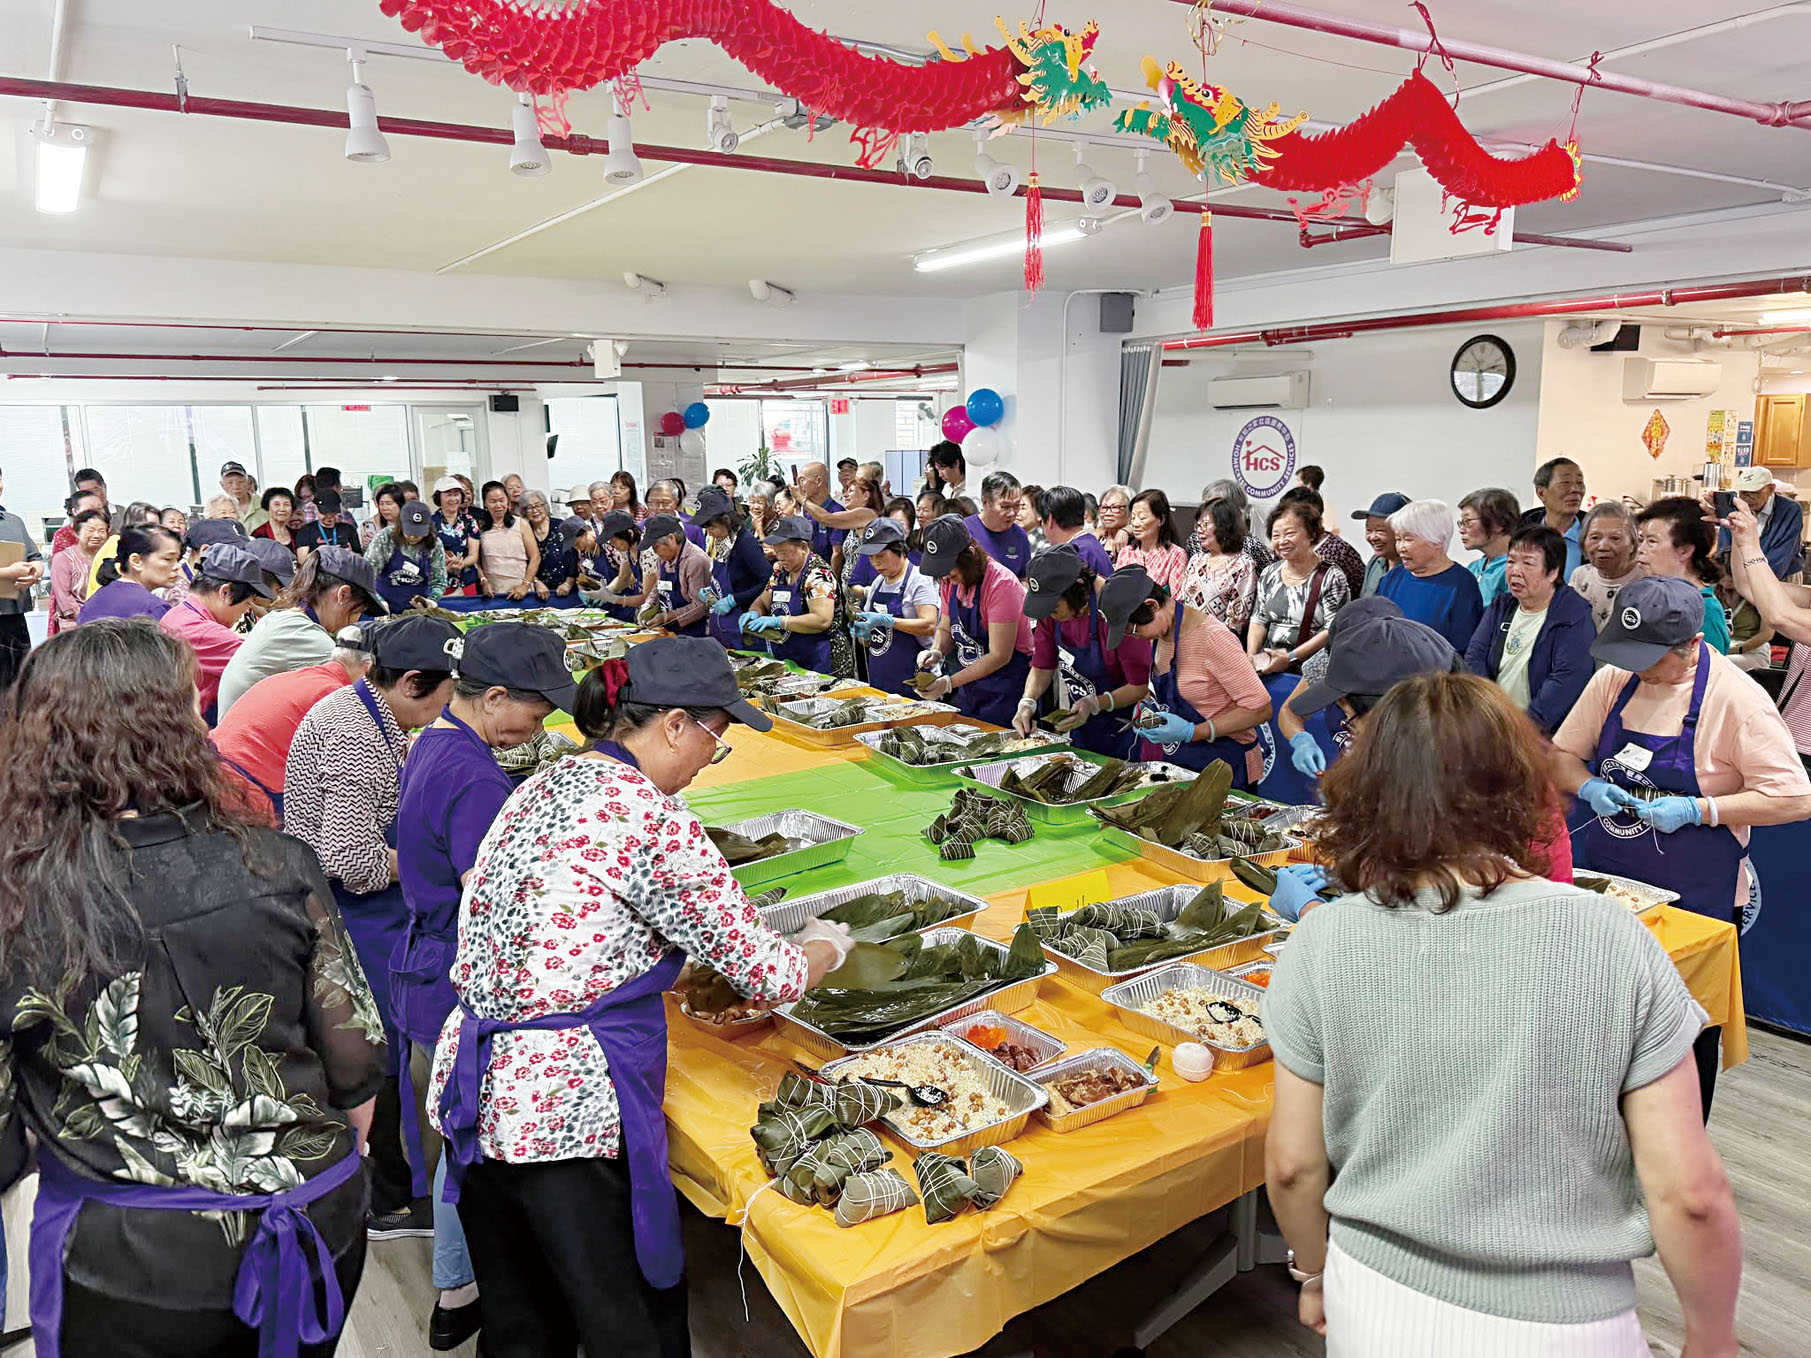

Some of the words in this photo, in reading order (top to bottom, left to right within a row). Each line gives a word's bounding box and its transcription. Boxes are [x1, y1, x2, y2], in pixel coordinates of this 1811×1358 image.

[1245, 454, 1280, 471] HCS
[1246, 480, 1285, 497] COMMUNITY
[1284, 443, 1294, 480] SERVICES
[871, 634, 884, 644] CS
[1067, 684, 1087, 696] CS
[1603, 818, 1643, 836] COMMUNITY
[1741, 880, 1757, 926] ERVICE
